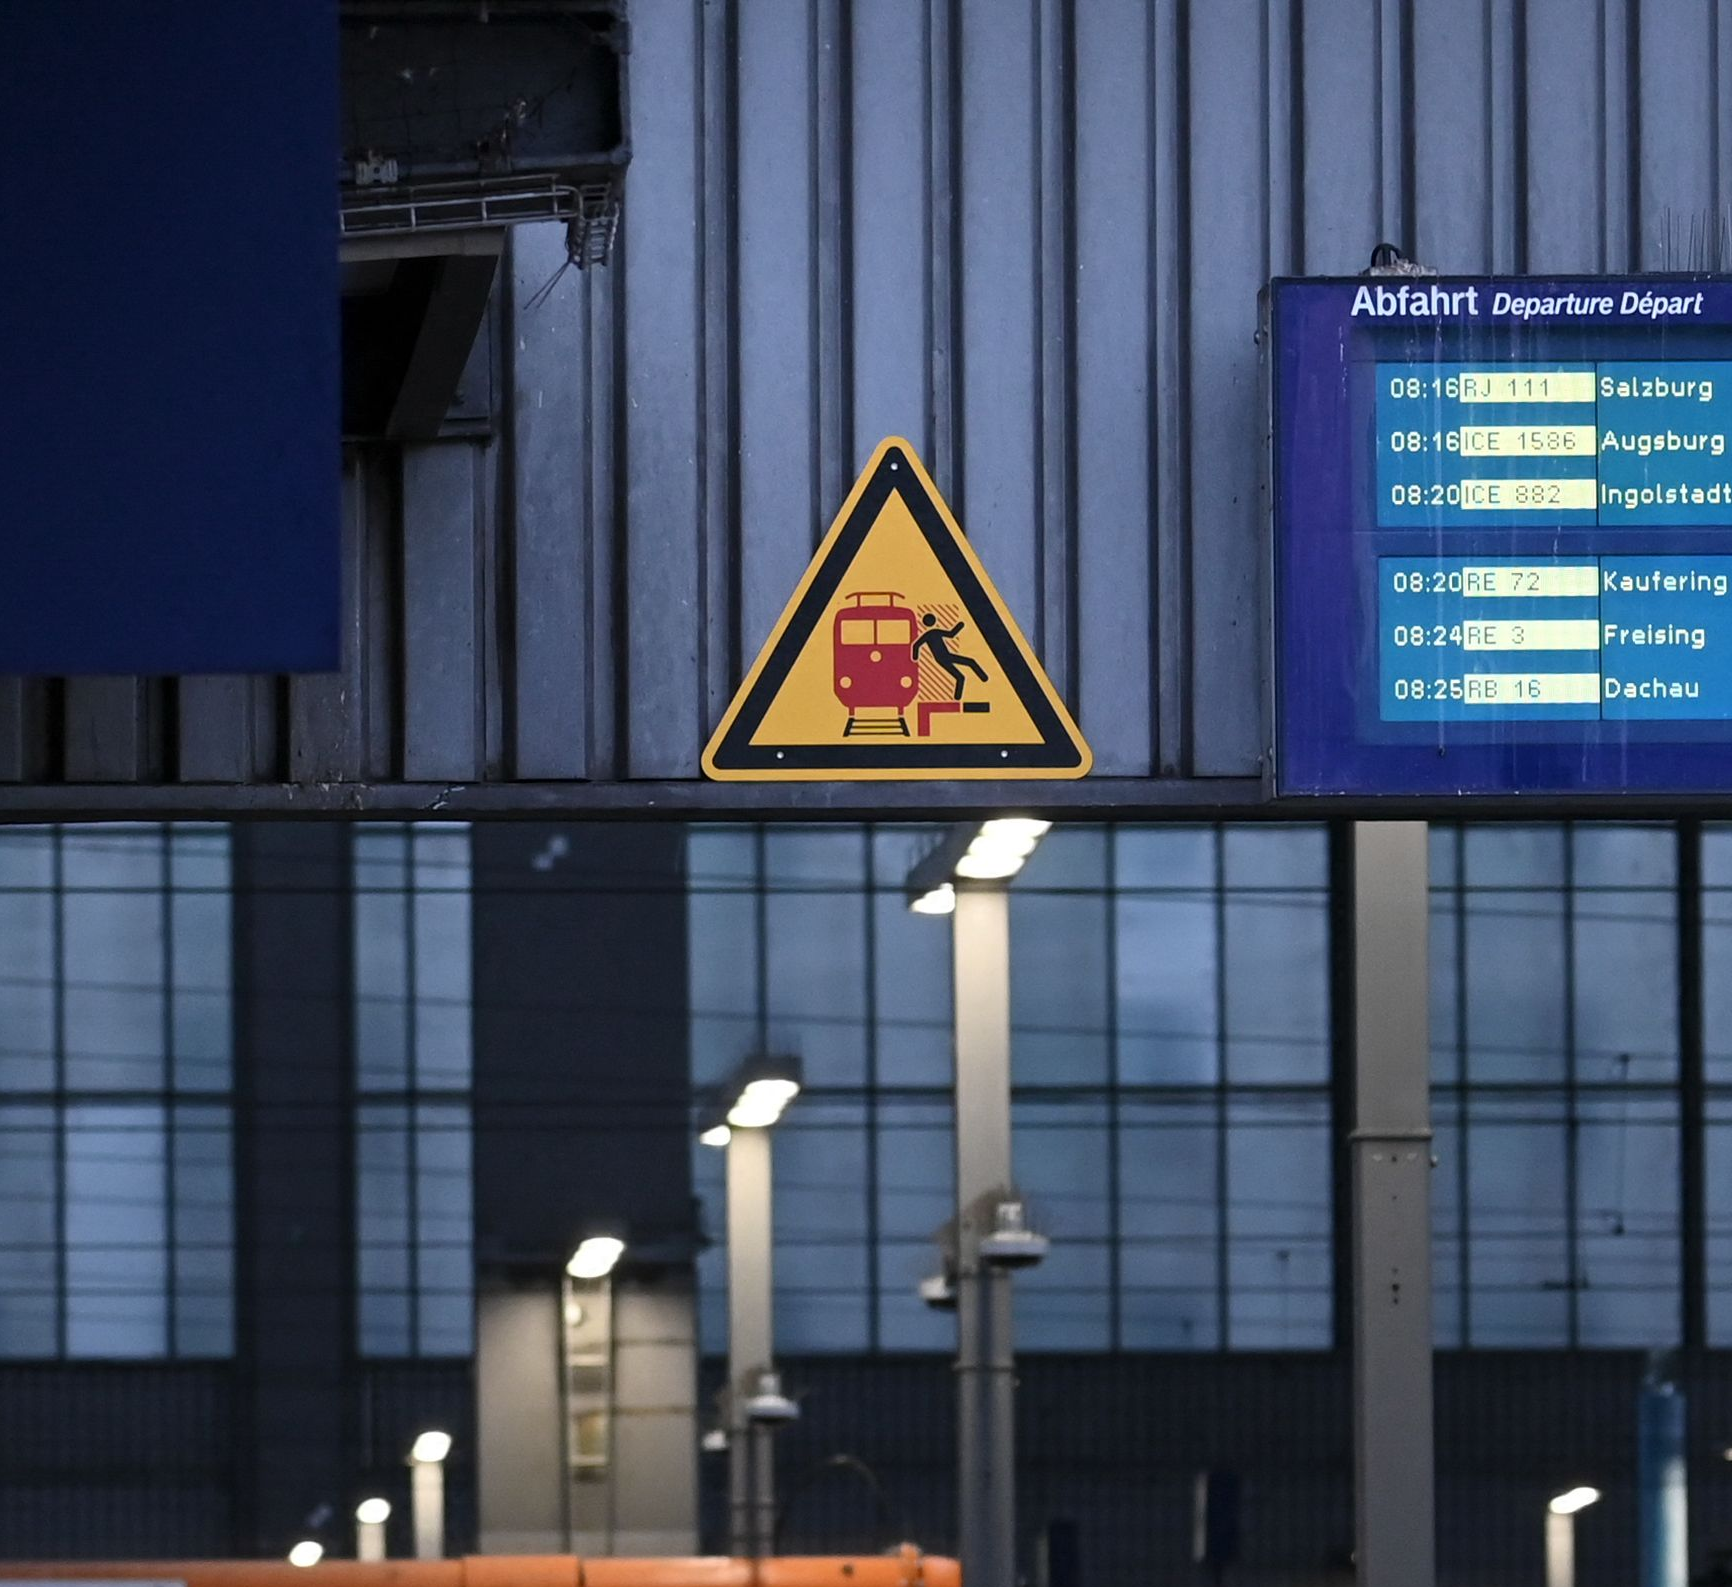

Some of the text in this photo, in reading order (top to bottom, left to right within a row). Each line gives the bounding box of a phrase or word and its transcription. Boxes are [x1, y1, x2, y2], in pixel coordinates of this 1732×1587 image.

[1351, 286, 1704, 320] Abfahrt Departure Départ
[1390, 377, 1459, 399] 08:16
[1464, 379, 1492, 398] RJ
[1508, 379, 1551, 398] 111
[1600, 377, 1714, 402] Salzburg
[1390, 431, 1460, 453] 08:16
[1464, 432, 1500, 451] ICE
[1517, 432, 1576, 451] 1586
[1601, 430, 1725, 455] Augsburg
[1391, 484, 1461, 506] 08:20
[1465, 485, 1500, 504] ICE
[1515, 485, 1561, 504] 882
[1601, 483, 1732, 509] Ingolstadt
[1394, 572, 1462, 593] 08:20
[1468, 573, 1496, 591] RE
[1511, 573, 1540, 591] 72
[1604, 570, 1728, 595] Kaufering
[1394, 625, 1463, 646] 08:24
[1468, 626, 1497, 645] RE
[1511, 626, 1525, 645] 3
[1604, 624, 1706, 648] Freising
[1394, 679, 1463, 699] 08:25
[1468, 679, 1497, 698] RB
[1514, 679, 1541, 698] 16
[1605, 678, 1700, 698] Dachau
